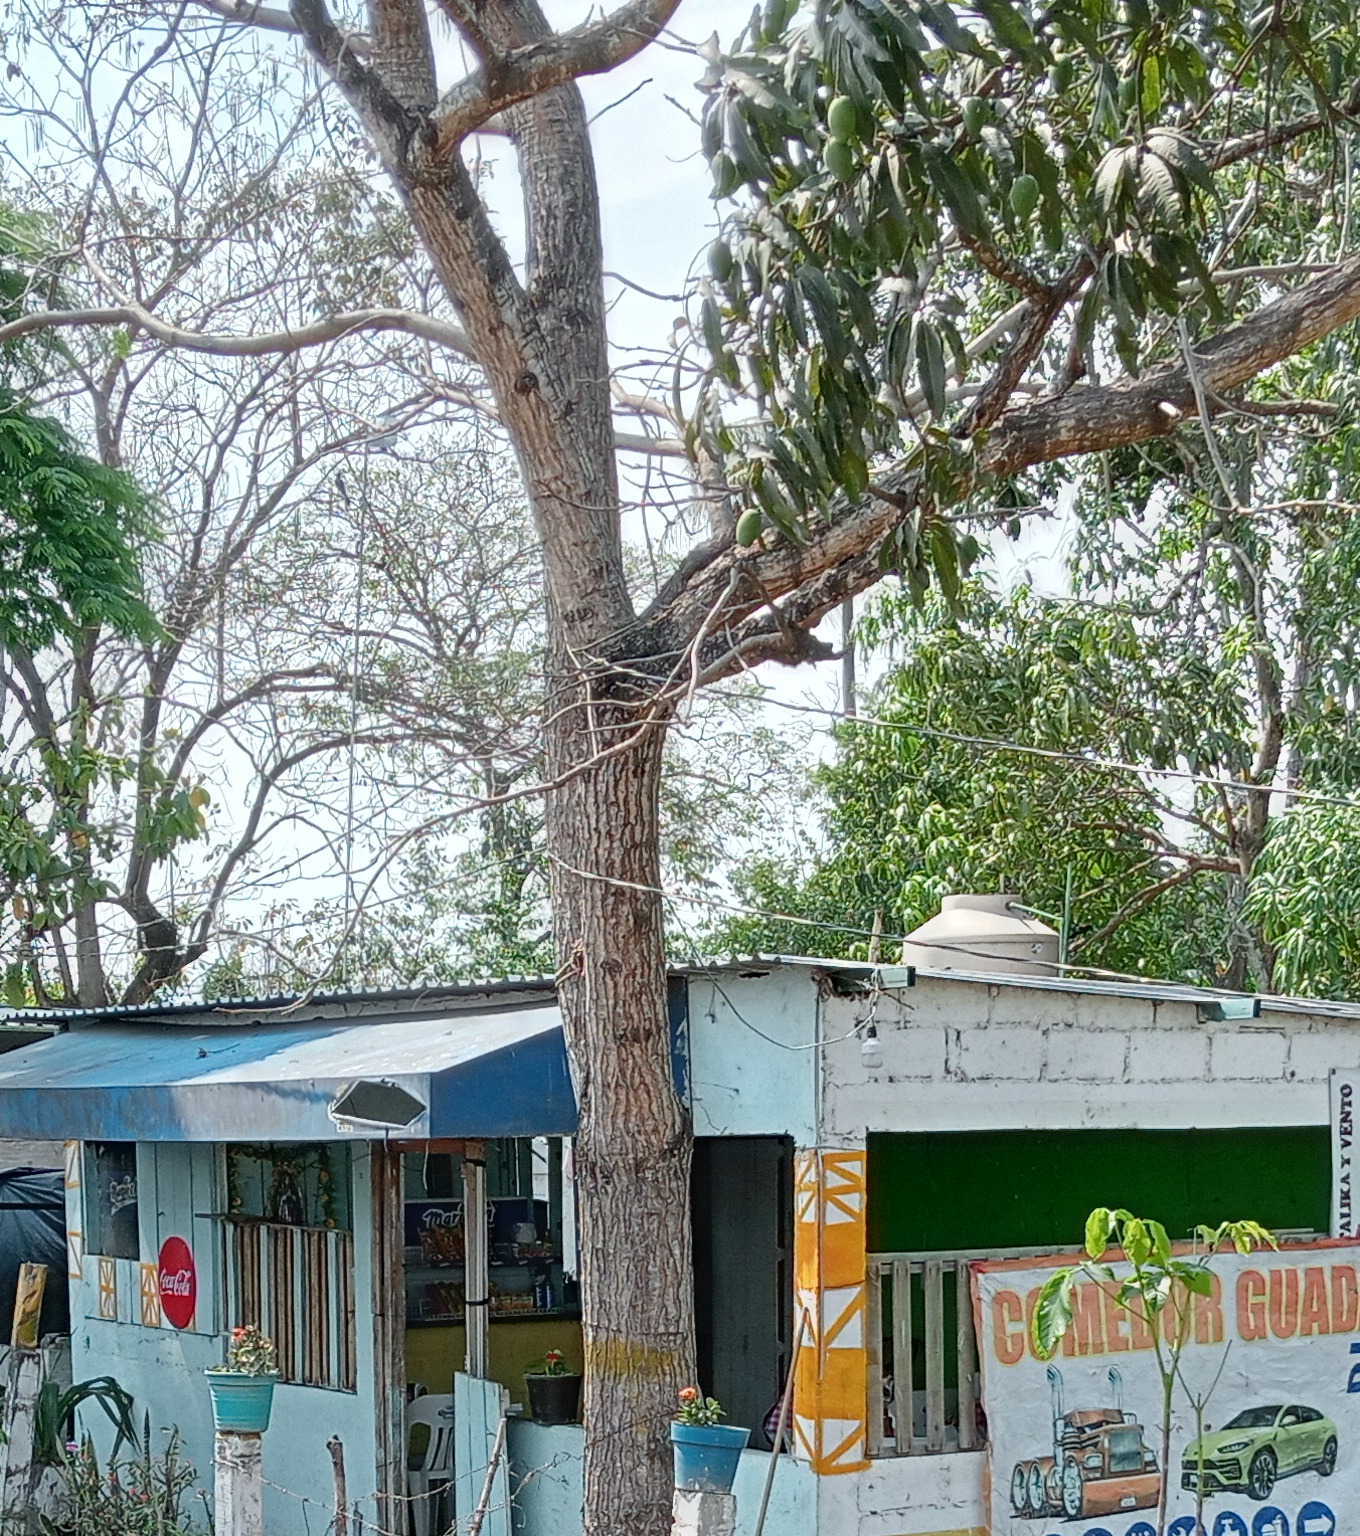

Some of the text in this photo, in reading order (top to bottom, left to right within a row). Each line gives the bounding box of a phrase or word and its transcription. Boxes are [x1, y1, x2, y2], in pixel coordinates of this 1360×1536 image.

[1340, 1083, 1352, 1237] ALIKA Y VENTO
